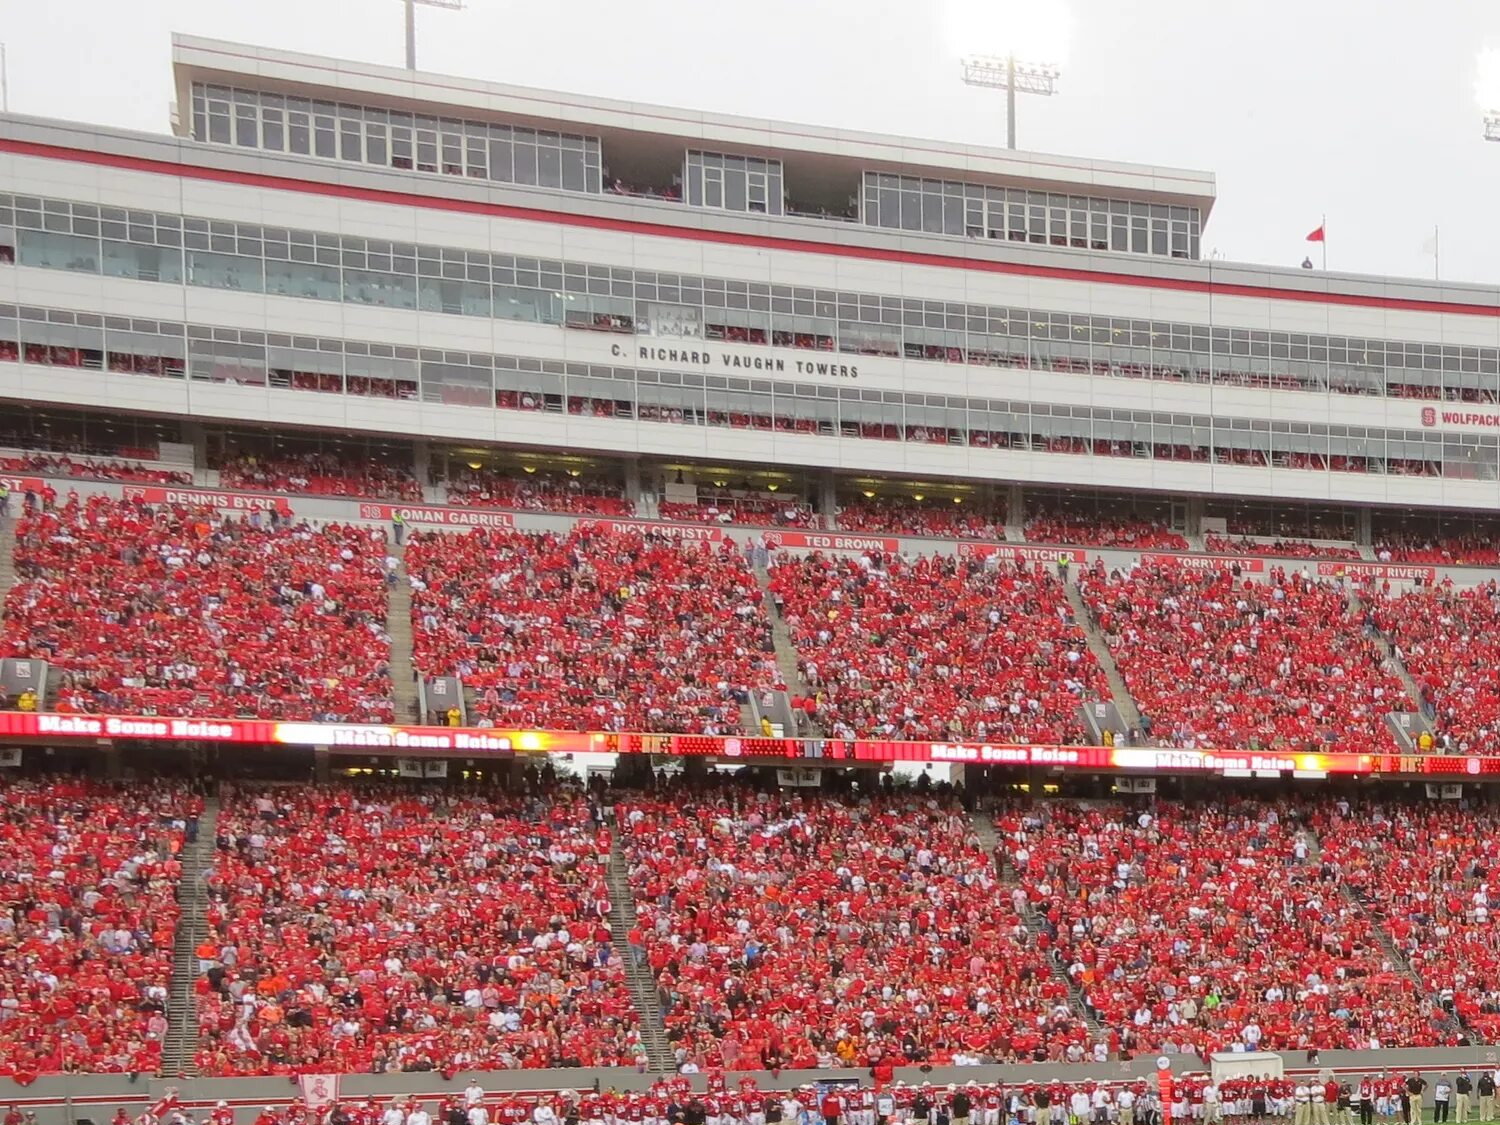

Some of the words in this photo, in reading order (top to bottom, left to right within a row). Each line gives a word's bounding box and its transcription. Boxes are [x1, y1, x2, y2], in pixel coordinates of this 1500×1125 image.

[611, 344, 627, 358] C.
[640, 346, 711, 365] RICHARD
[722, 353, 785, 372] VAUGHN
[796, 361, 859, 378] TOWERS
[1442, 412, 1500, 427] WOLFPACK
[166, 490, 228, 508] DENNIS
[449, 511, 511, 527] GABRIEL
[804, 536, 831, 548] TED
[835, 538, 885, 550] BROWN
[994, 547, 1015, 559] JIM
[1387, 567, 1430, 579] RIVERS
[37, 715, 101, 735] Make
[106, 717, 167, 736] Some
[172, 718, 233, 738] Noise
[931, 744, 977, 760] Make
[981, 746, 1028, 762] Some
[1031, 747, 1078, 763] Noise
